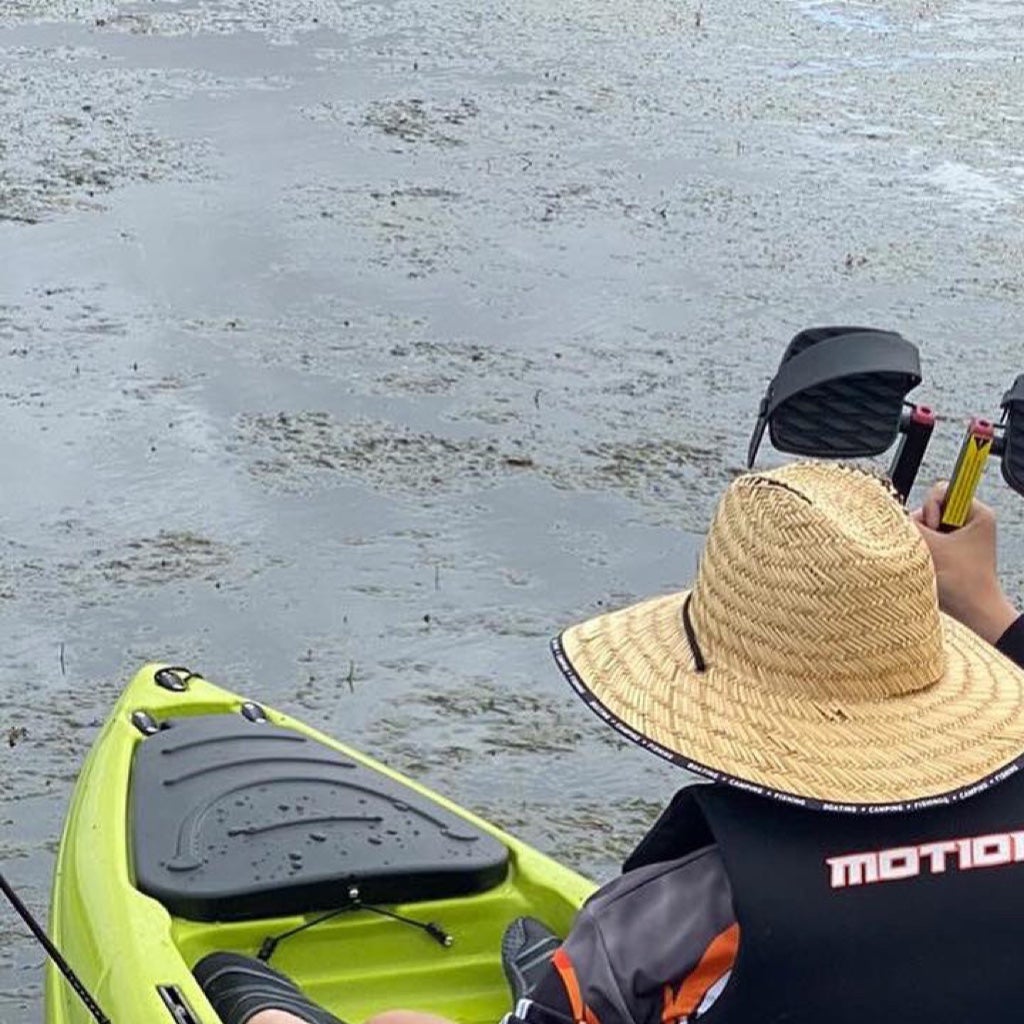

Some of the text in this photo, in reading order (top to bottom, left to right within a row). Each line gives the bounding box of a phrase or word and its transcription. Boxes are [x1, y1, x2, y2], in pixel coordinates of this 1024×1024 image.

[728, 778, 763, 794] CAMPING
[774, 792, 806, 806] FISHING
[822, 803, 857, 813] BOATING
[868, 804, 903, 814] CAMPING
[913, 797, 950, 809] FISHING
[959, 783, 988, 800] CAMPING
[994, 764, 1019, 781] FISHING
